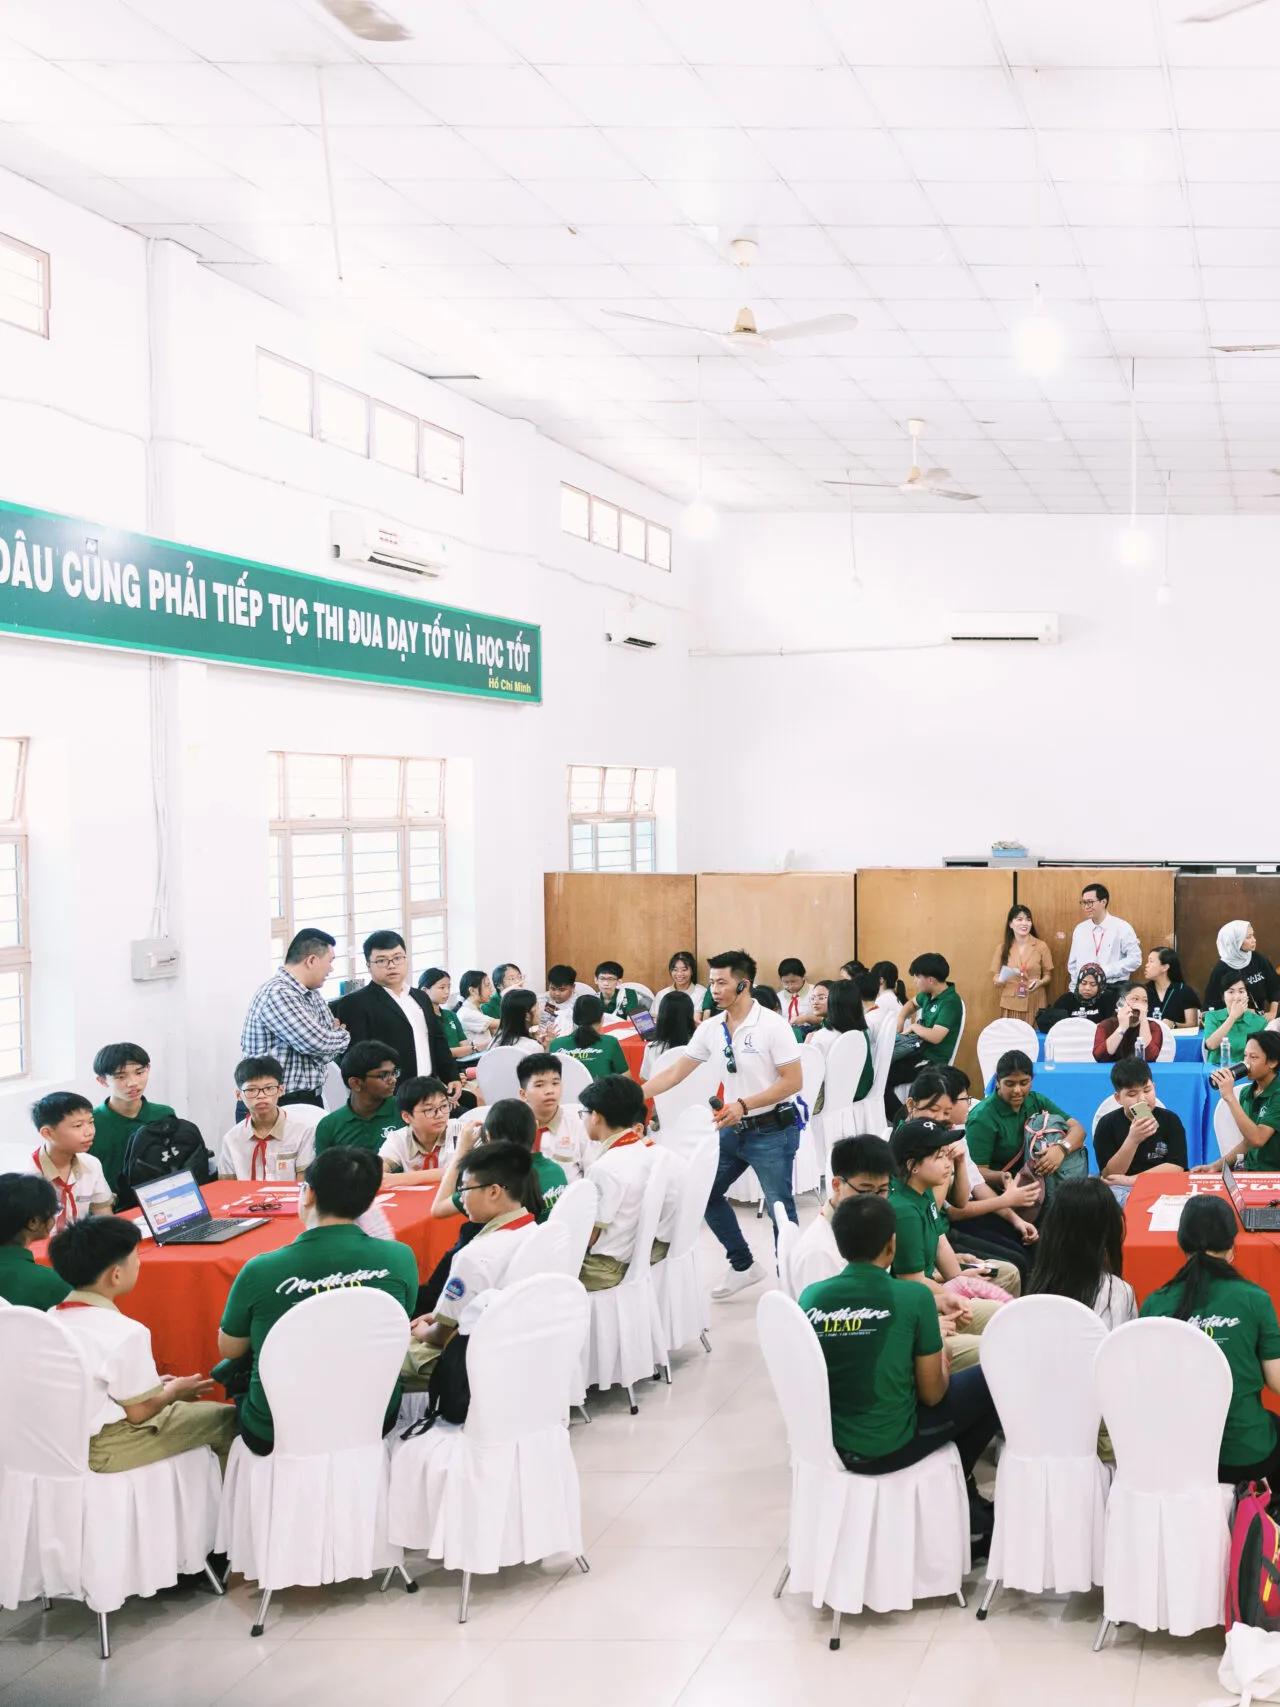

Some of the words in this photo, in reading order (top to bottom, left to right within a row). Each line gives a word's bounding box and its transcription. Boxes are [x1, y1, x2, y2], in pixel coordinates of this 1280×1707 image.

[148, 560, 207, 619] PHẢI
[212, 571, 263, 628] TIẾP
[268, 593, 308, 644] TỤC
[313, 602, 344, 642] THI
[348, 609, 384, 649] ĐUA
[387, 617, 419, 662] DẠY
[422, 612, 450, 659] TỐT
[454, 624, 474, 664] VÀ
[476, 634, 504, 675] HỌC
[506, 630, 531, 673] TỐT
[514, 681, 532, 693] Minh
[824, 1317, 862, 1333] LEAD
